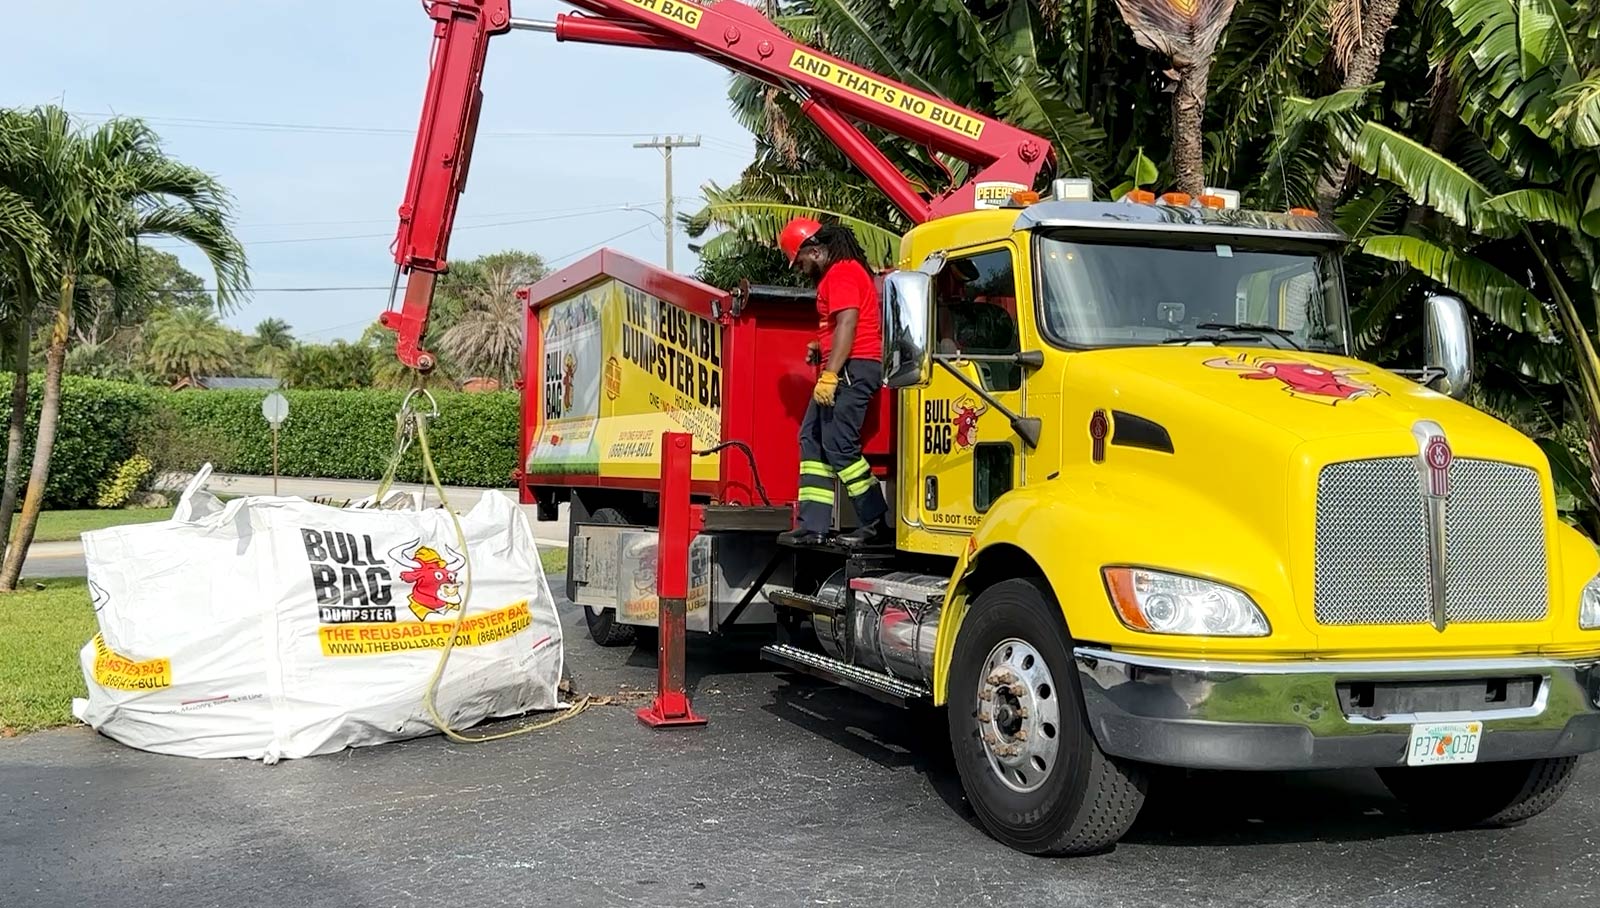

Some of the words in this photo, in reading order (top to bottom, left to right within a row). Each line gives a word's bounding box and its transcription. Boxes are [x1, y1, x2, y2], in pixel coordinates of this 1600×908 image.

[661, 1, 698, 24] BAG
[793, 54, 831, 78] AND
[836, 69, 896, 104] THAT'S
[899, 95, 926, 114] NO
[929, 107, 982, 137] BULL!
[623, 286, 648, 331] THE
[546, 350, 562, 382] BULL
[622, 322, 694, 399] DUMPSTER
[546, 381, 562, 420] BAG
[649, 392, 660, 409] ONE
[924, 399, 951, 423] BULL
[924, 425, 951, 454] BAG
[933, 513, 944, 523] US
[945, 514, 961, 524] DOT
[300, 528, 386, 566] BULL
[310, 563, 392, 606] BAG
[322, 608, 392, 621] DUMPSTER
[325, 628, 355, 642] THE
[359, 622, 440, 642] REUSABLE
